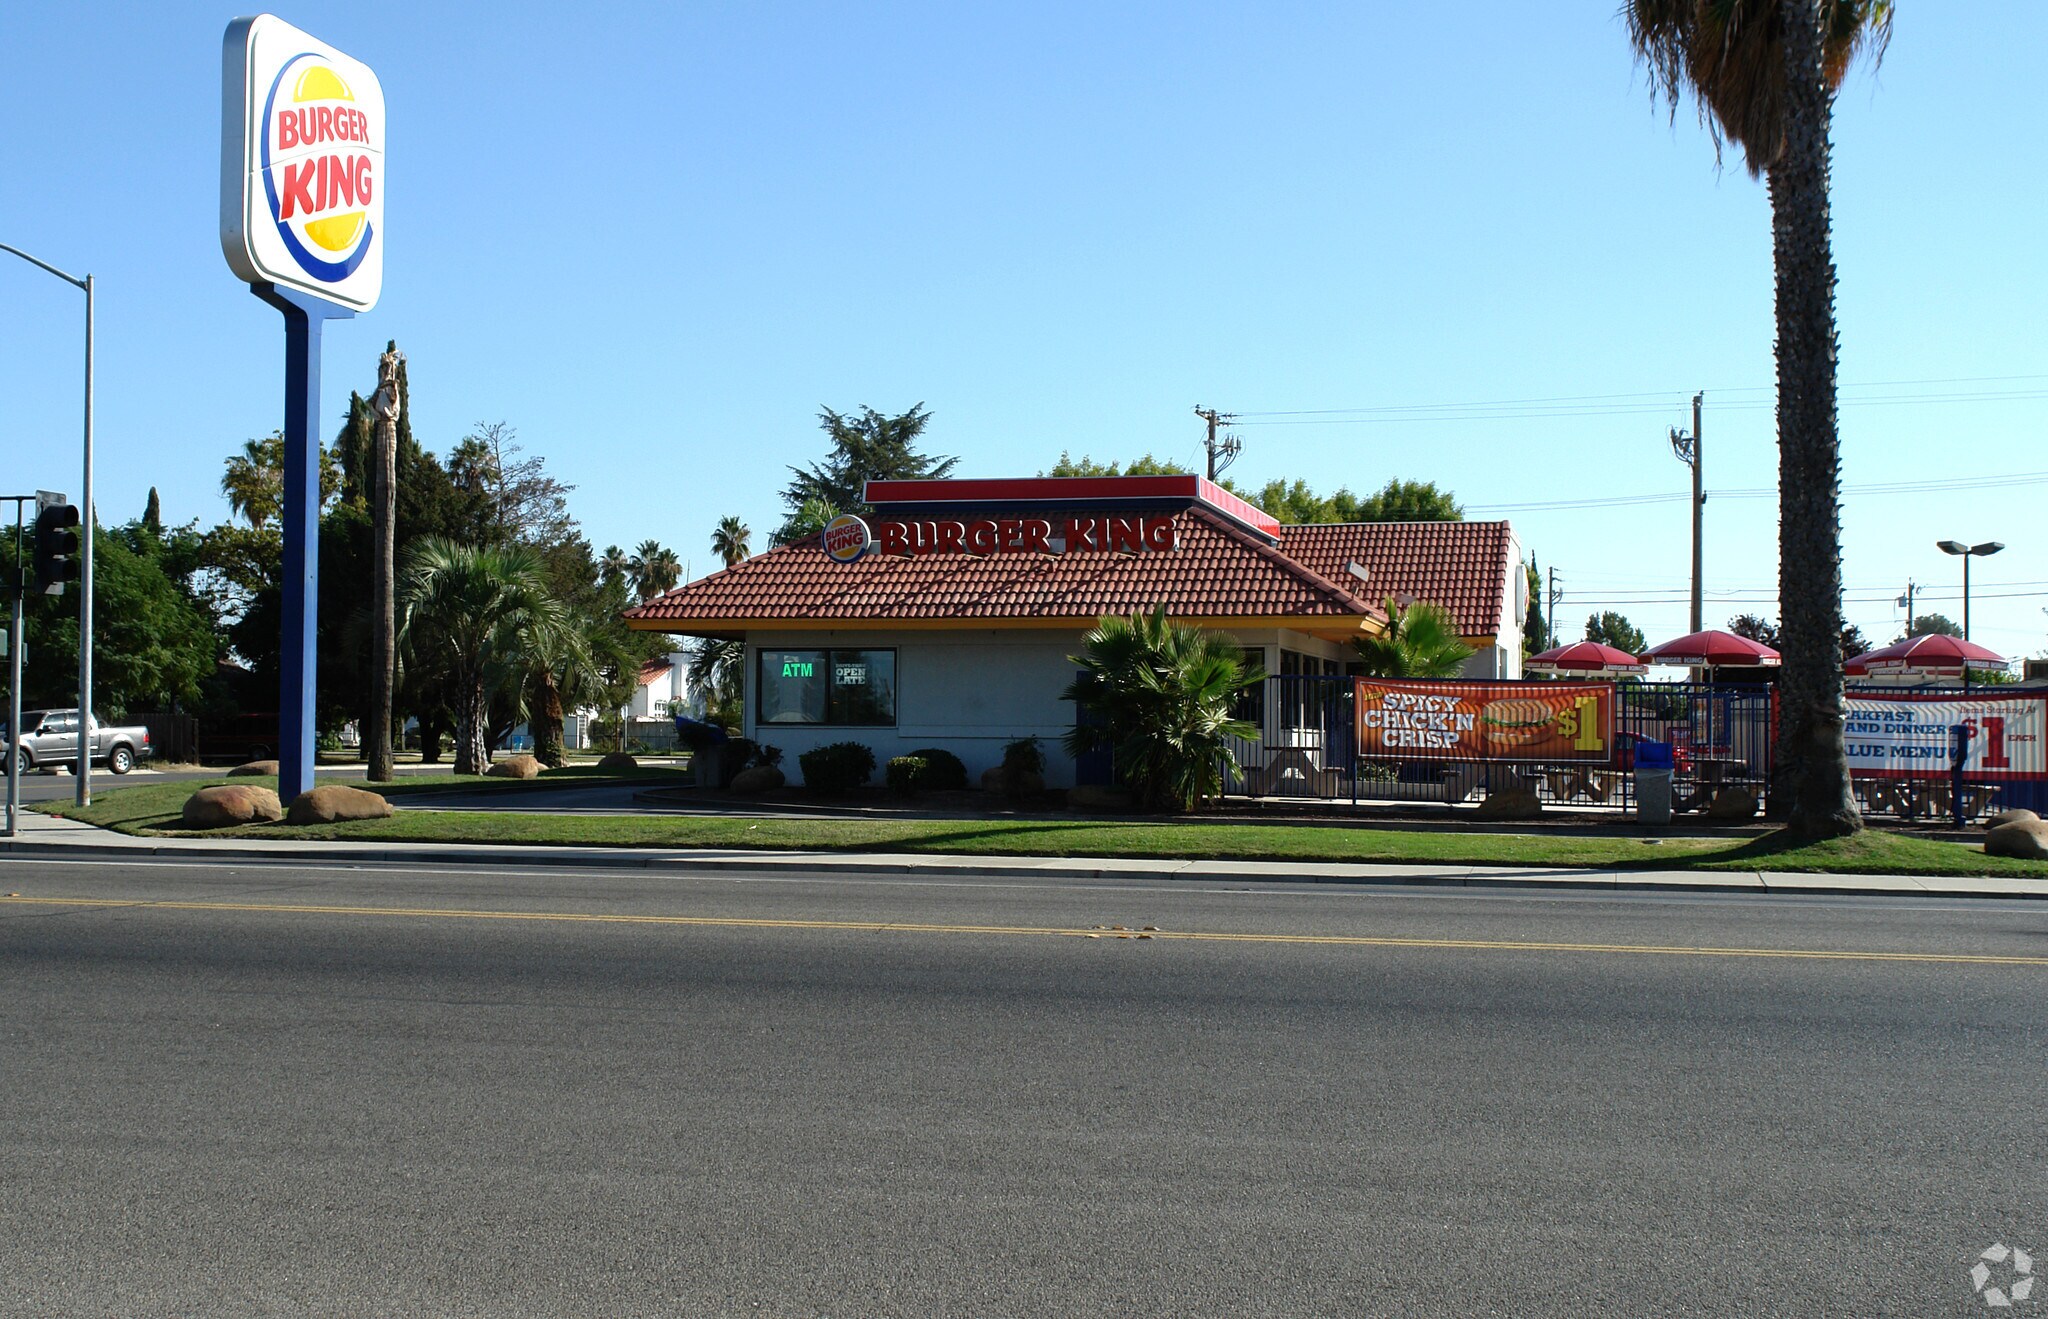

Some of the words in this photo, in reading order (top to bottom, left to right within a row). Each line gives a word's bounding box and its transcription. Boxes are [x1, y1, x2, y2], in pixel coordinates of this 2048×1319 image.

[278, 107, 369, 150] BURGER
[281, 154, 372, 221] KING
[826, 523, 862, 541] BURGER
[880, 519, 1051, 555] BURGER
[1065, 517, 1178, 553] KING
[827, 532, 864, 554] KING
[782, 663, 813, 677] ATM
[835, 668, 866, 676] OPEN
[835, 676, 866, 685] LATE
[1383, 692, 1462, 712] SPICY
[1986, 706, 2024, 715] Starting
[1364, 709, 1475, 731] CHICK'N
[1558, 696, 1603, 751] $1
[1845, 722, 1881, 734] AND
[1884, 723, 1946, 735] DINNER
[2008, 734, 2037, 742] EACH
[1844, 744, 1885, 757] LUE
[1890, 746, 1946, 758] MENU
